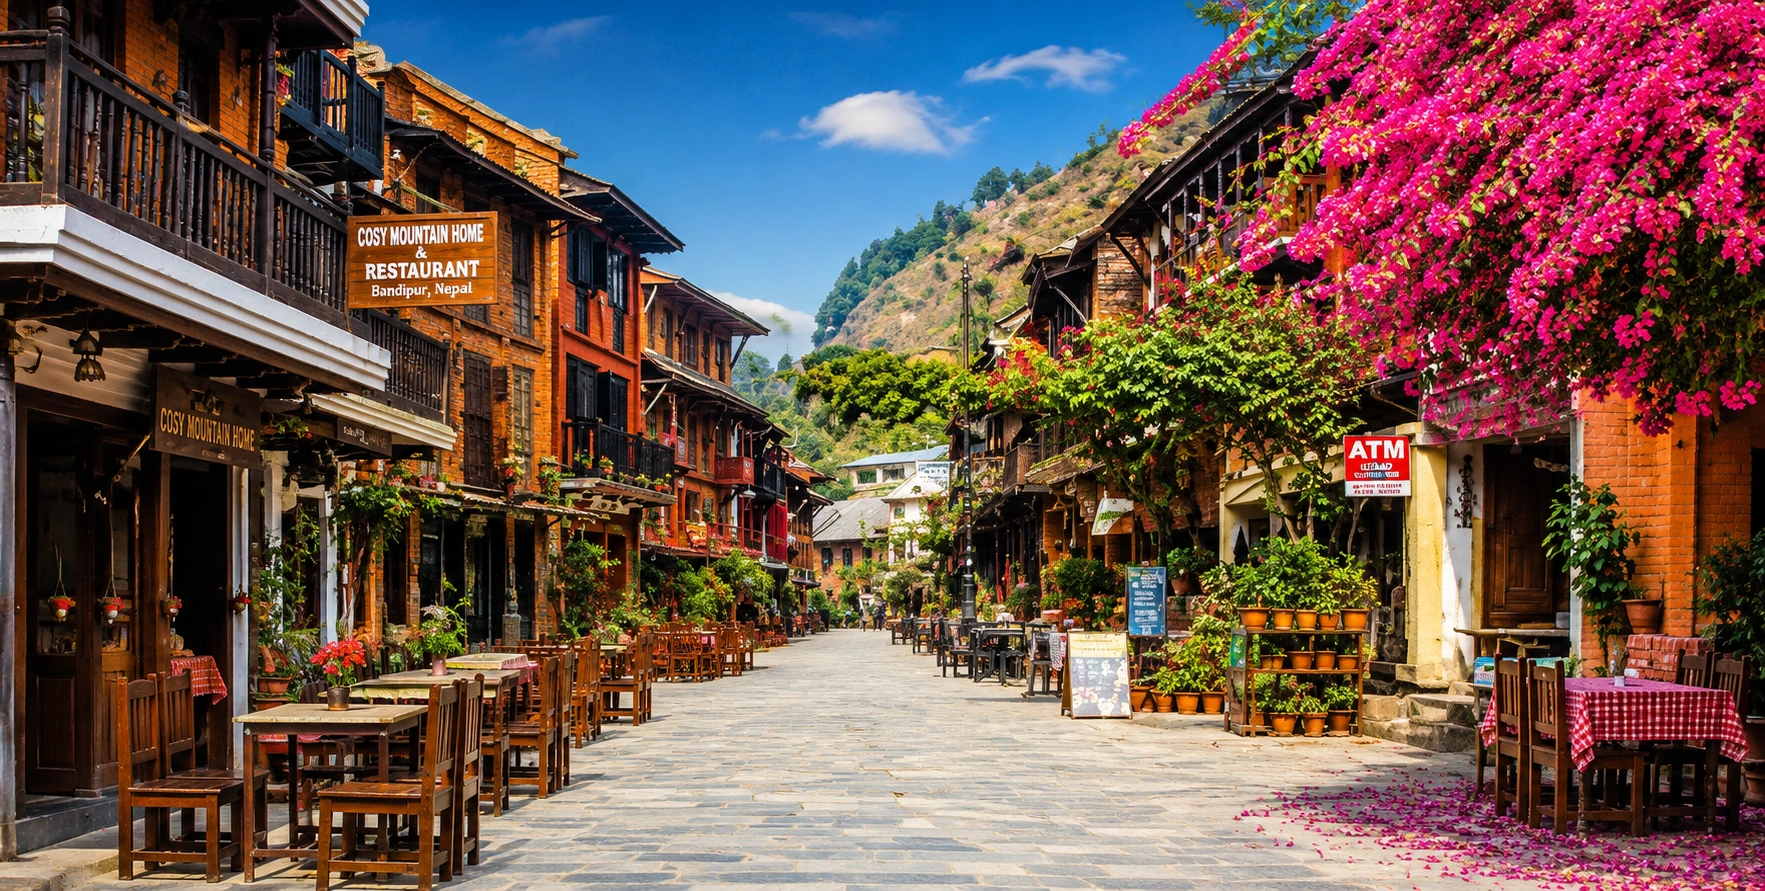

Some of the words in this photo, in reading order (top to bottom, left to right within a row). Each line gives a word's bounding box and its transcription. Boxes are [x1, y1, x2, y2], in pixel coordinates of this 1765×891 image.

[358, 226, 387, 247] COSY
[390, 224, 448, 245] MOUNTAIN
[451, 223, 484, 243] HOME
[415, 246, 427, 259] &
[365, 260, 480, 280] RESTAURANT
[371, 284, 431, 299] Bandipur,
[435, 282, 473, 298] Nepal
[160, 407, 185, 435] COSY
[187, 414, 230, 446] MOUNTAIN
[232, 425, 255, 452] HOME
[1348, 440, 1405, 459] ATM
